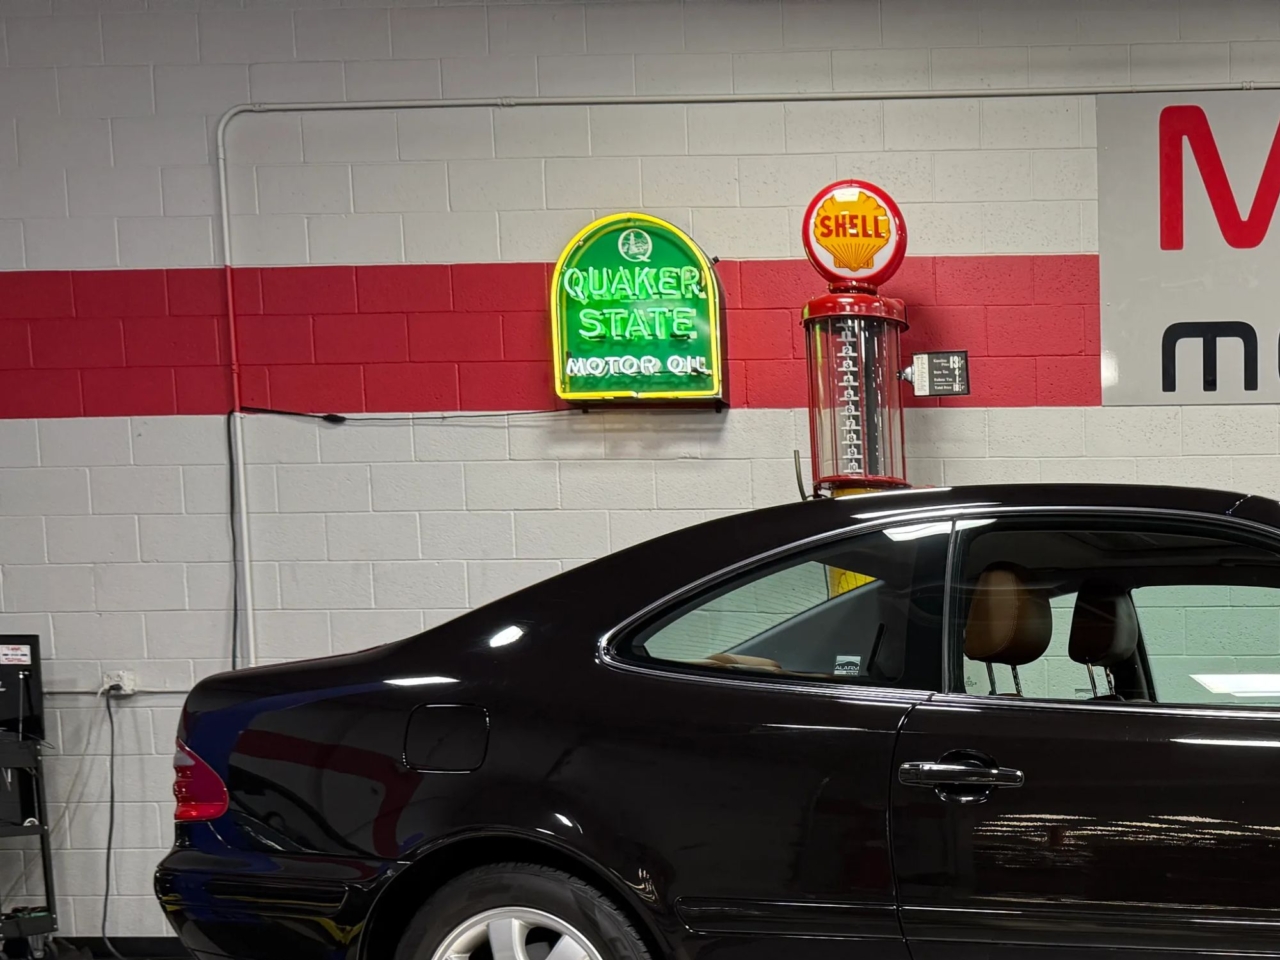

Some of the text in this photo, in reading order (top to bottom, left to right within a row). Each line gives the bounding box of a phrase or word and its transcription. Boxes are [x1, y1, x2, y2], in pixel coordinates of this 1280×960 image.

[820, 214, 886, 238] SHELL
[563, 266, 704, 303] QUAKER
[579, 307, 697, 340] STATE
[566, 355, 710, 376] MOTOR OIL
